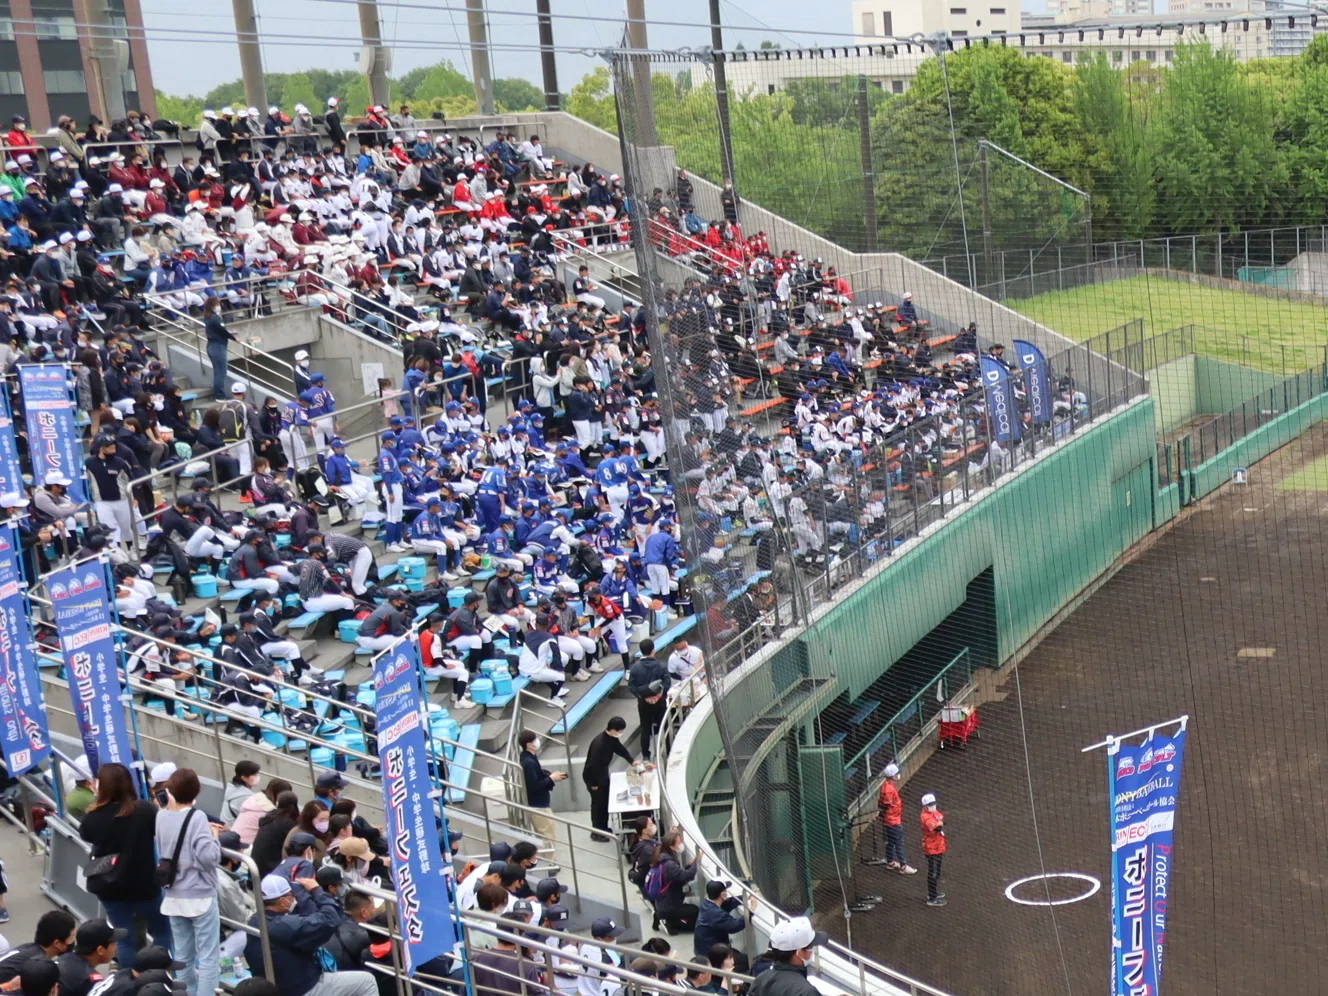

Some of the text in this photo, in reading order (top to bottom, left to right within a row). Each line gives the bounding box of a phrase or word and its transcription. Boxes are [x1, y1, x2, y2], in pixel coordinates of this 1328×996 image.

[1022, 353, 1035, 365] D
[987, 370, 999, 381] D
[1155, 844, 1172, 899] Protect
[1155, 901, 1168, 930] Our
